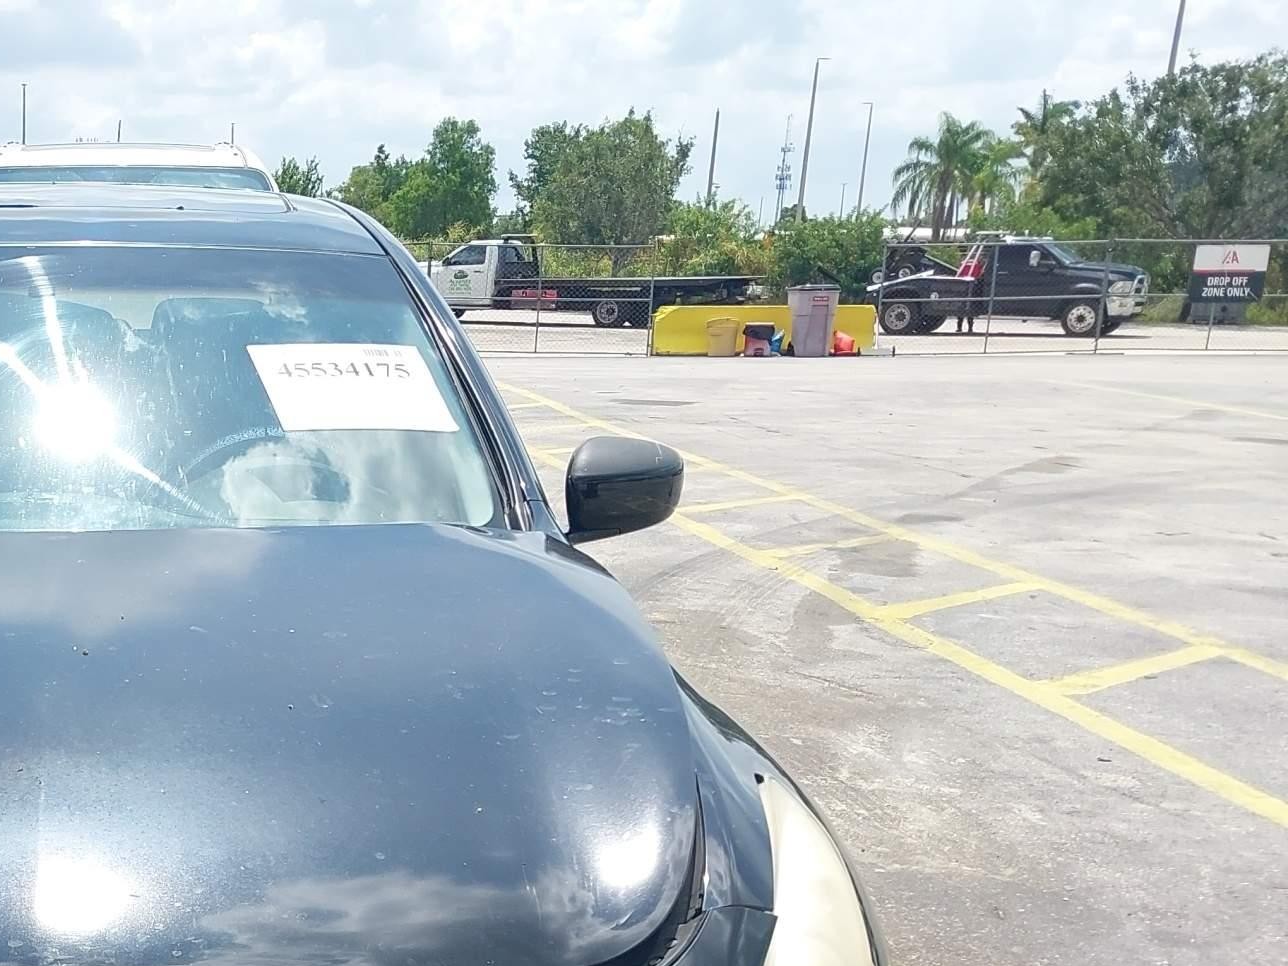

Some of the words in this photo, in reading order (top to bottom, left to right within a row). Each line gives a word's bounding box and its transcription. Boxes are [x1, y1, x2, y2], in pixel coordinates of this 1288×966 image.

[1207, 277, 1230, 286] DROP
[1232, 277, 1249, 286] OFF
[1202, 288, 1225, 297] ZONE
[1227, 288, 1251, 297] ONLY
[278, 362, 411, 378] 45534175
